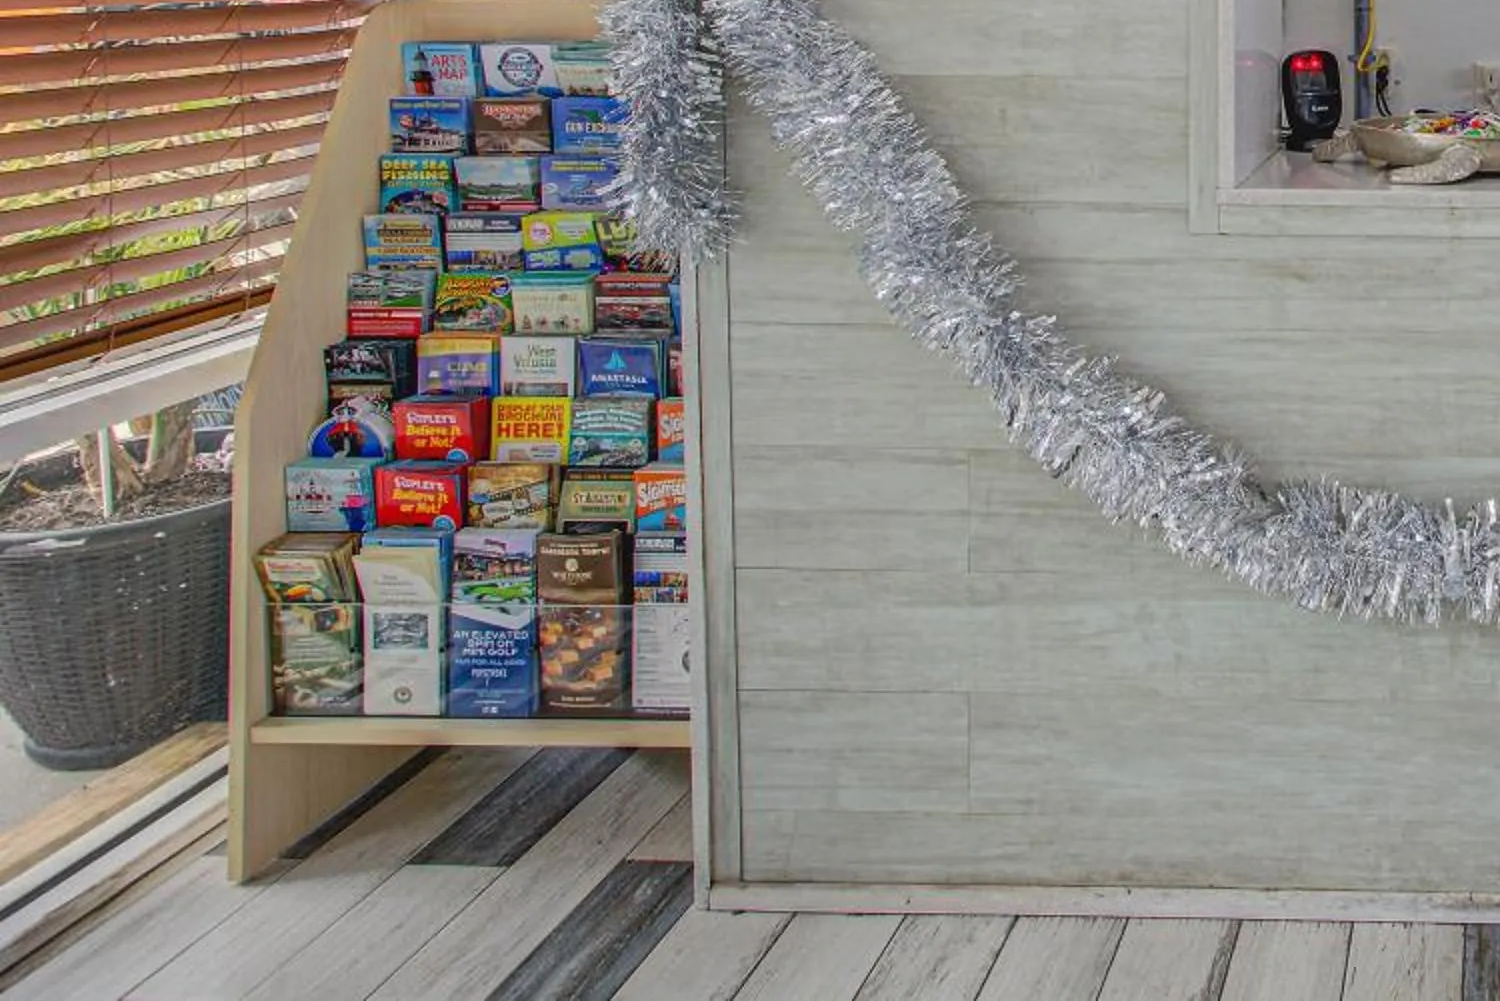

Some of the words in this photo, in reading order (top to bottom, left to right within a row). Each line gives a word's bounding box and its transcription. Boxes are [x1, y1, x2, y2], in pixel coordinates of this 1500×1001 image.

[431, 54, 467, 67] ARTS
[382, 159, 416, 170] DEEP
[422, 159, 449, 170] SEA
[382, 170, 449, 180] FISHING
[497, 422, 565, 438] HERE!
[414, 438, 428, 448] or
[430, 436, 457, 448] Not!
[400, 504, 415, 513] or
[416, 502, 442, 515] Not!
[453, 630, 469, 639] AN
[471, 630, 529, 639] ELEVATED
[497, 639, 514, 648] ON
[487, 648, 518, 656] GOLF
